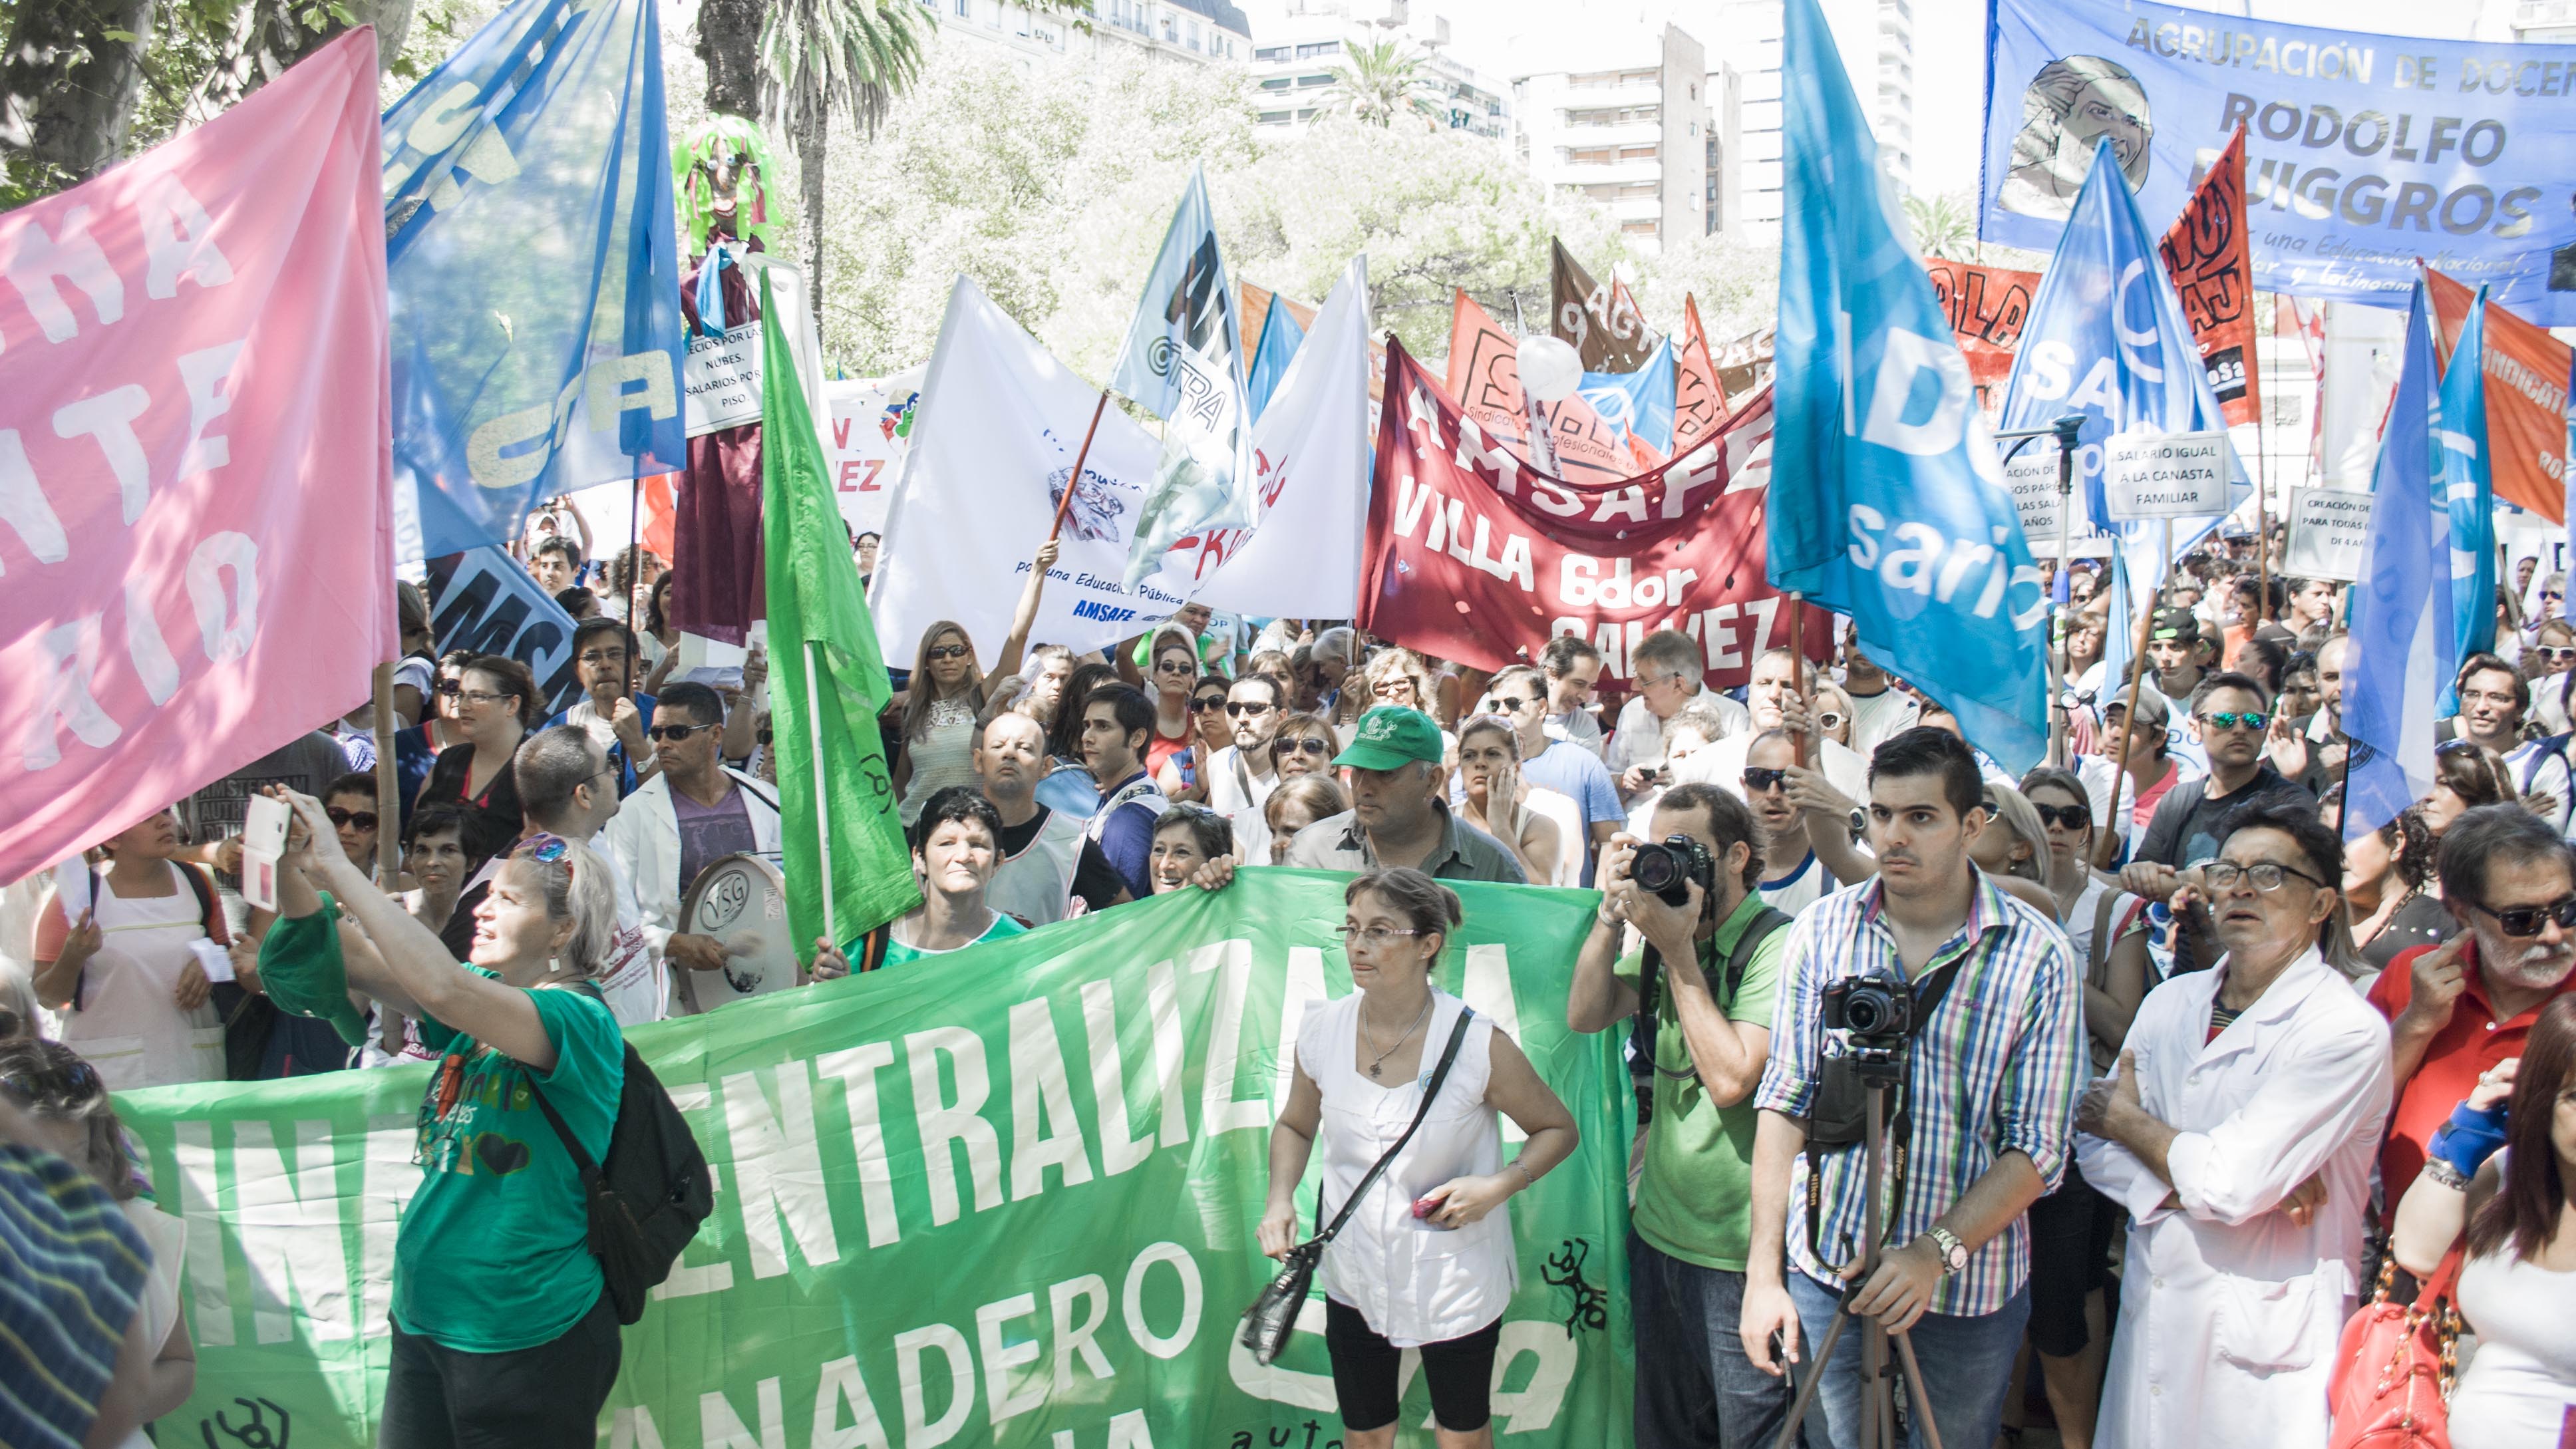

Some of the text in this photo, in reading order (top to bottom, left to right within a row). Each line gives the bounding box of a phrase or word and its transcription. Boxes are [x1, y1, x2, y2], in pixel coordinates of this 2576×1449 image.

[2125, 17, 2375, 84] AGRUPACIÓN
[2392, 53, 2437, 90] DE
[2217, 92, 2507, 168] RODOLFO
[2263, 231, 2309, 252] una
[687, 339, 719, 355] ECIOS
[722, 332, 744, 346] POR
[705, 353, 745, 371] NUBES.
[685, 370, 762, 397] SALARIOS POR
[2117, 446, 2173, 462] SALARIO
[2175, 445, 2217, 459] IGUAL
[2007, 464, 2056, 478] ACIÓN DE
[2120, 468, 2214, 484] A LA CANASTA
[2016, 501, 2036, 511] LAS
[2136, 491, 2199, 505] FAMILIAR
[2307, 500, 2371, 513] CREACIÓN DE
[2023, 516, 2054, 528] AÑOS
[2303, 517, 2329, 526] PARA
[2331, 518, 2362, 530] TODAS
[1392, 474, 1535, 593] VILLA
[1015, 561, 1184, 605] po una Educaci Pública
[1072, 599, 1137, 623] AMSAFE
[201, 802, 243, 821] AUTH
[1895, 1144, 1905, 1180] Nikon
[1810, 1173, 1820, 1207] Nikon
